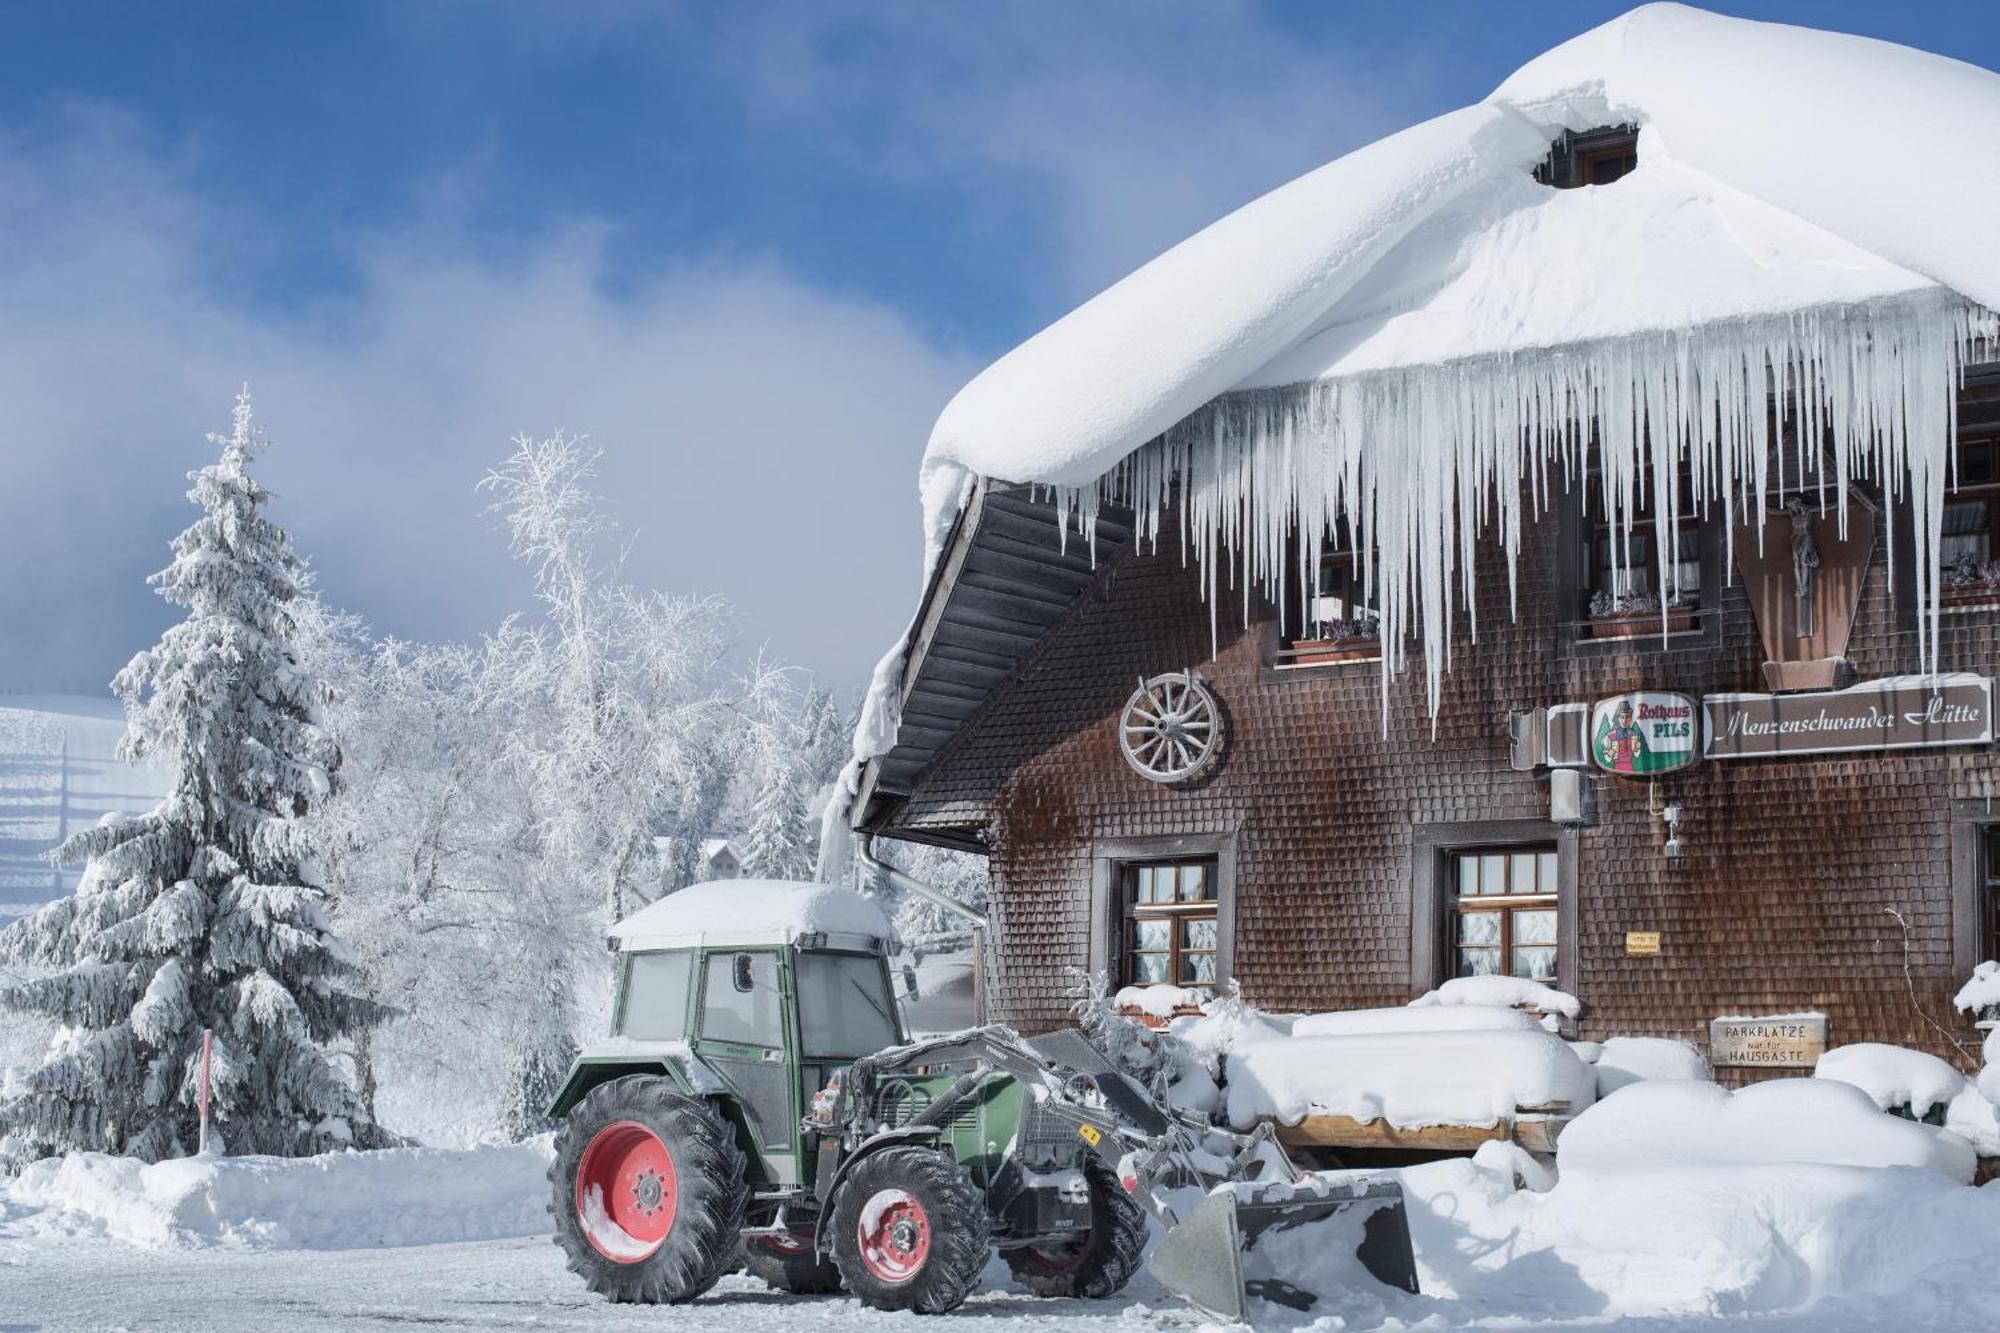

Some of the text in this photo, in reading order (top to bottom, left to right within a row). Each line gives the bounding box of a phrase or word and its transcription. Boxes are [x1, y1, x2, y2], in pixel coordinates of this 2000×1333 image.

[1637, 703, 1690, 720] Rothaus
[1714, 696, 1980, 741] Menzenschwander Hütte
[1653, 722, 1690, 737] PILS
